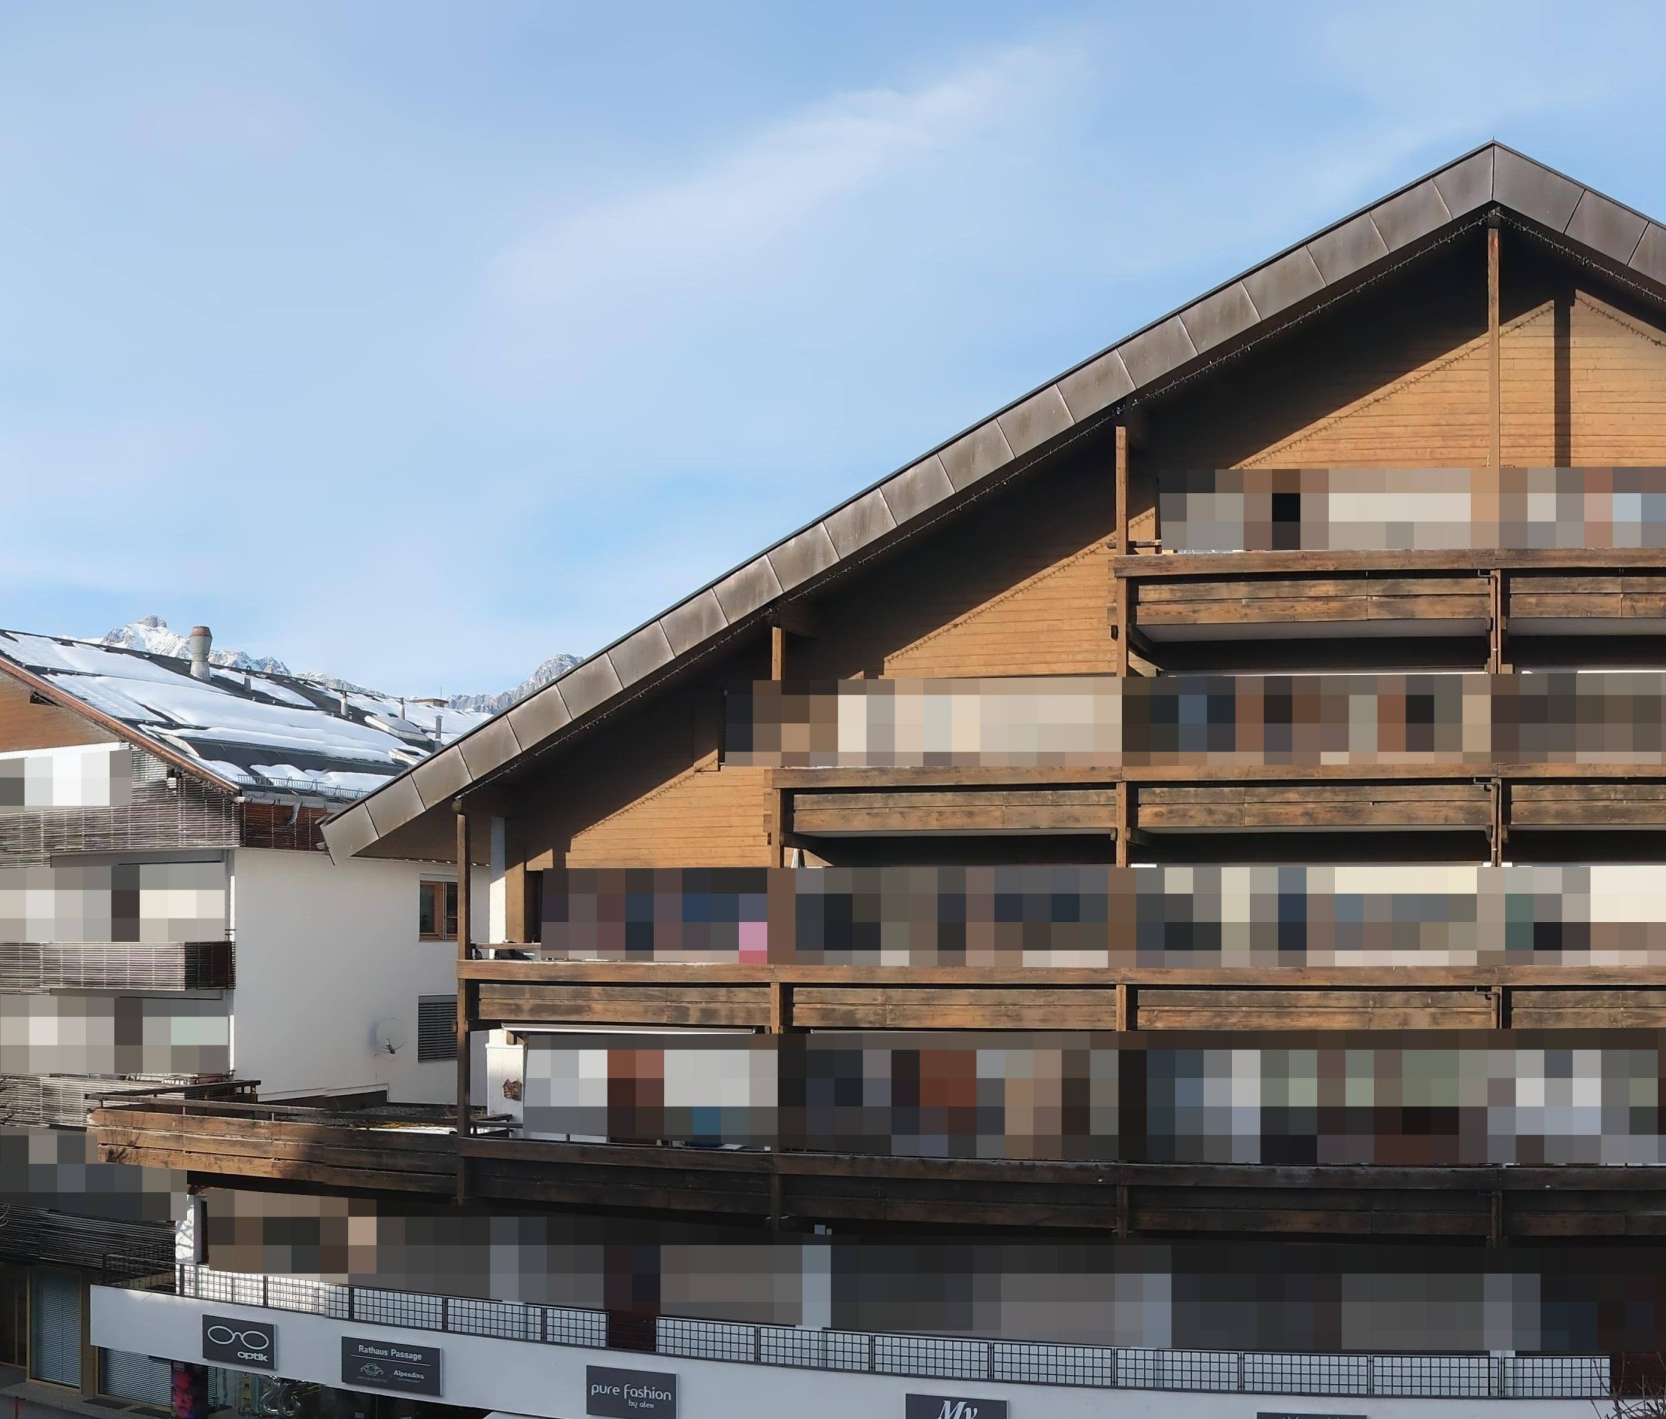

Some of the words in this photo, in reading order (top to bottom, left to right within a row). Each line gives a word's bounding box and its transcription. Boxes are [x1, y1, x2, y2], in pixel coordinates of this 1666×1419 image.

[237, 1351, 269, 1362] optik
[358, 1344, 388, 1356] Rathaus
[391, 1349, 422, 1361] Passage
[591, 1384, 620, 1396] pure
[624, 1383, 671, 1401] fashion
[628, 1399, 637, 1408] by
